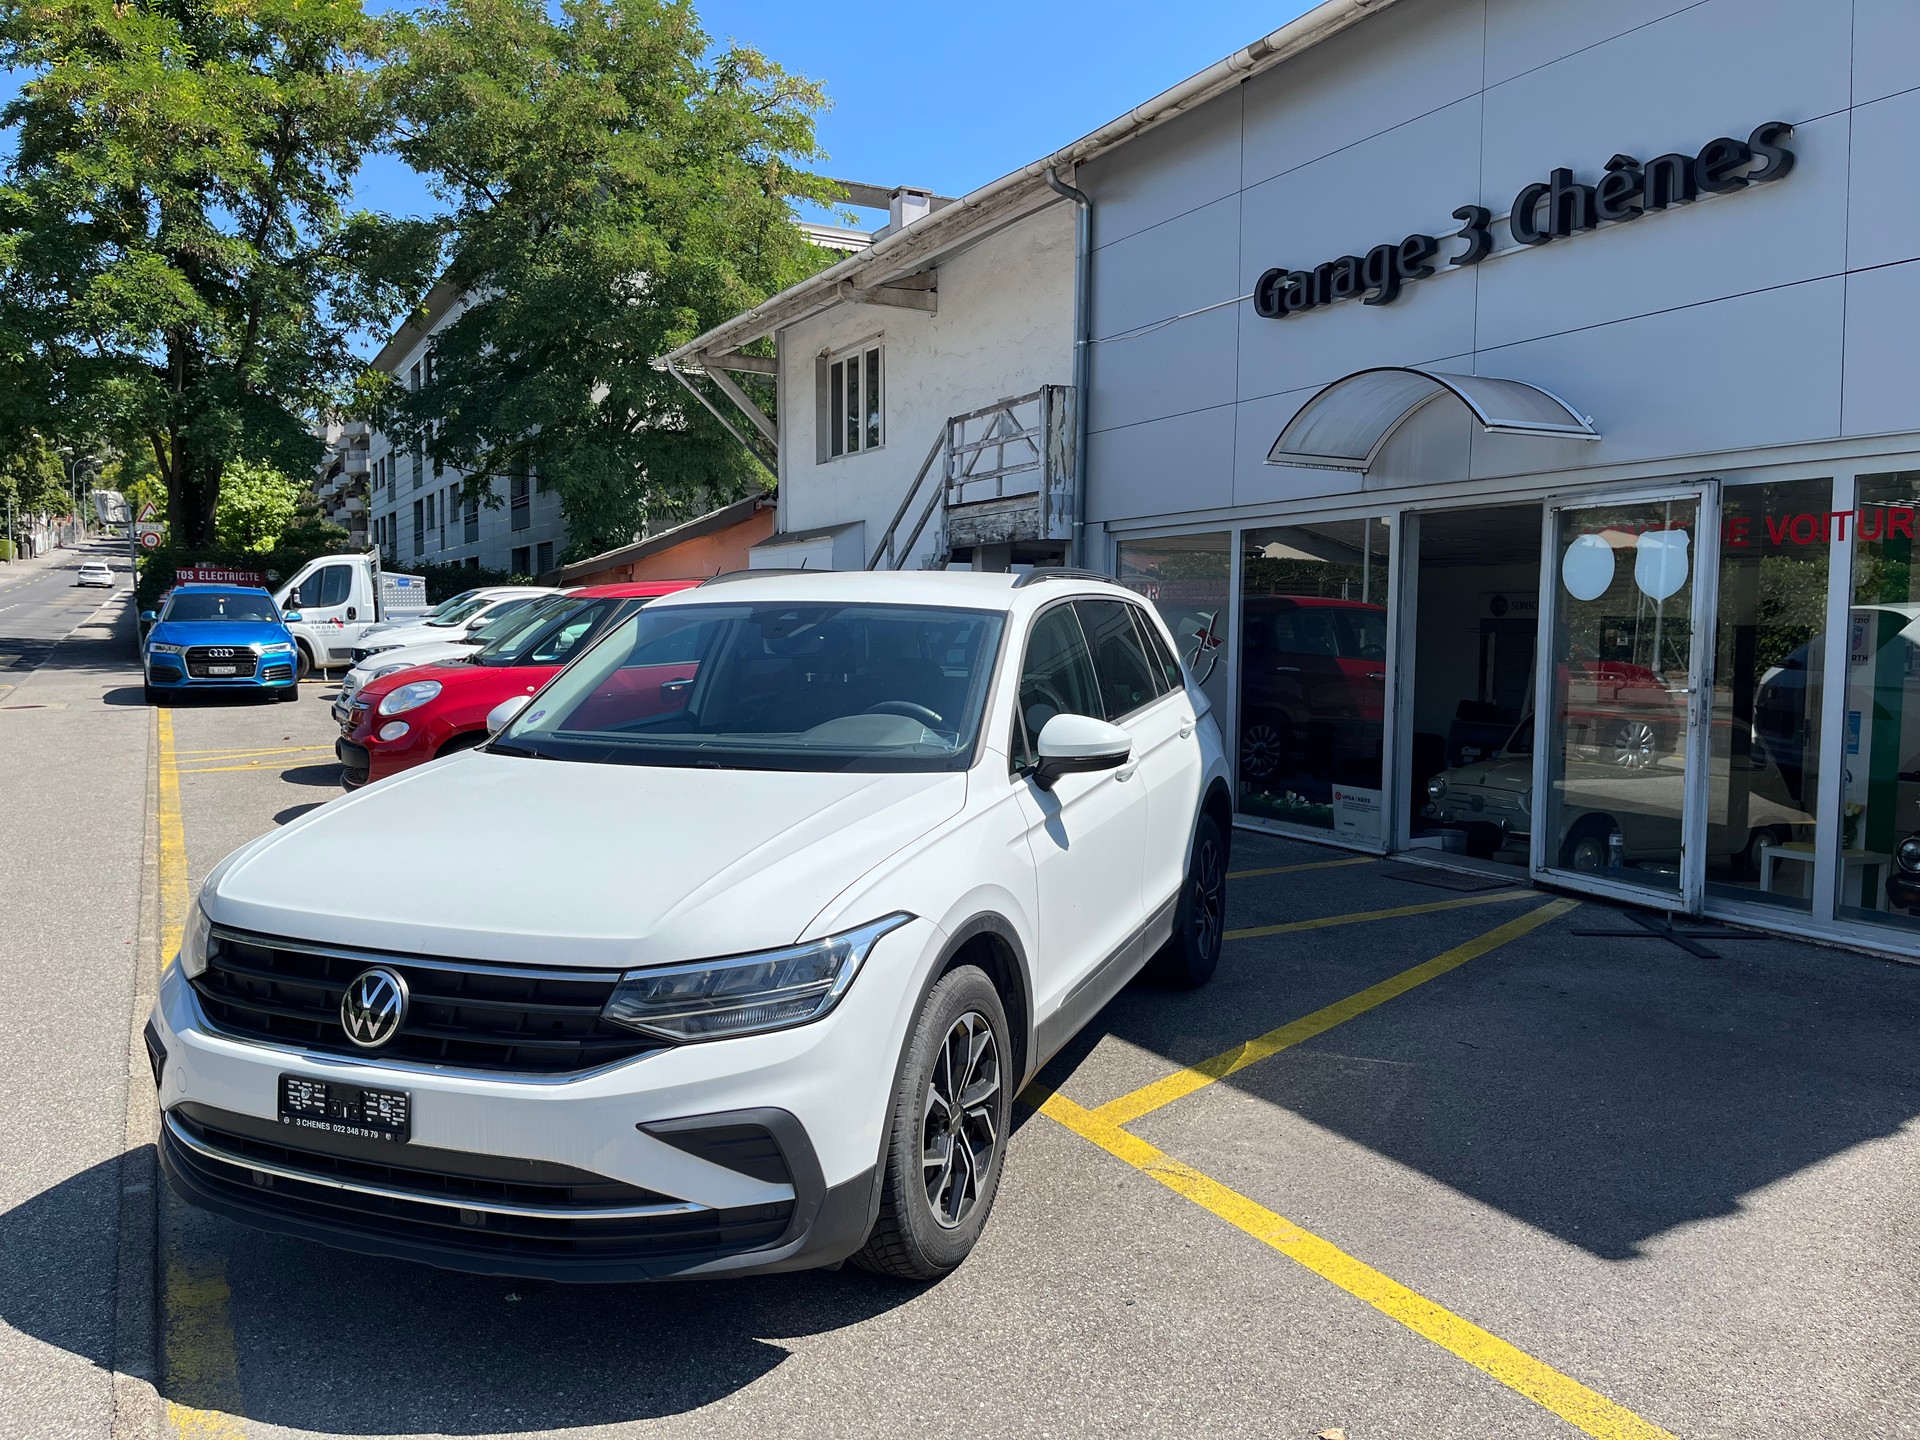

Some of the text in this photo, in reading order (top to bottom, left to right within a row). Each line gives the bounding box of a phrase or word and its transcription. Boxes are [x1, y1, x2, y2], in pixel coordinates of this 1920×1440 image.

[1254, 121, 1795, 319] Garage 3 Chênes
[1721, 516, 1752, 547] E
[1766, 507, 1920, 546] VOITUR
[296, 1118, 379, 1139] 3 CHENES 022 348 78 79
